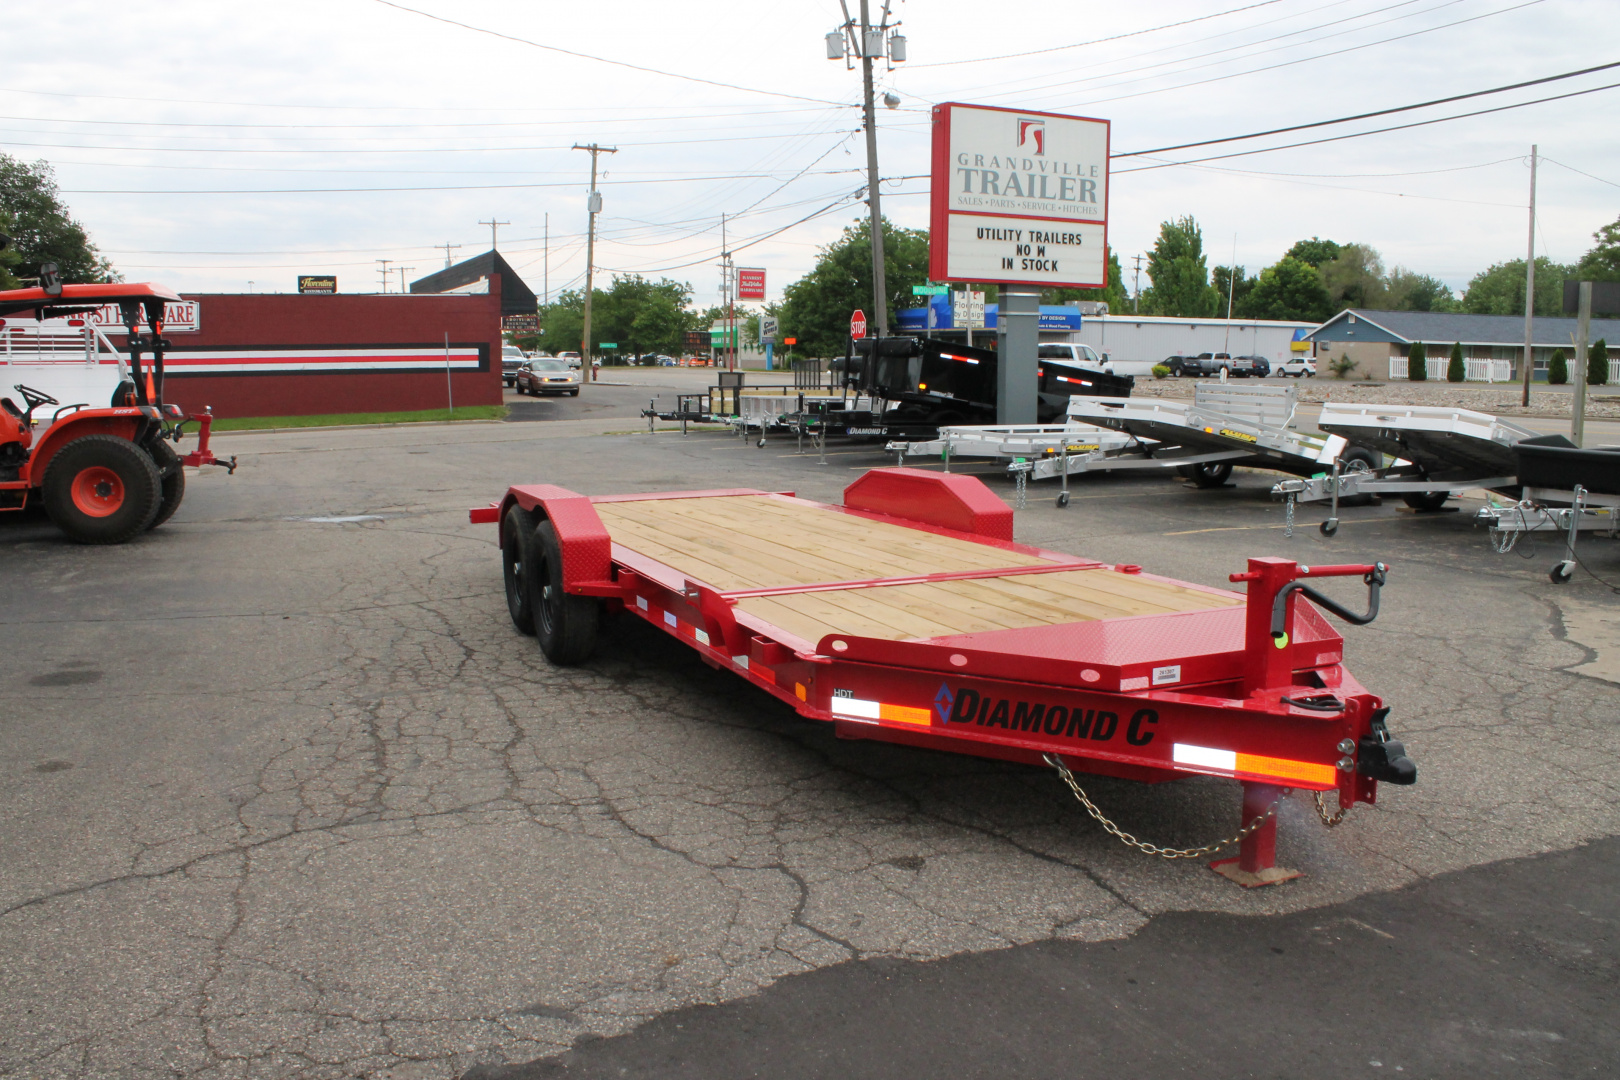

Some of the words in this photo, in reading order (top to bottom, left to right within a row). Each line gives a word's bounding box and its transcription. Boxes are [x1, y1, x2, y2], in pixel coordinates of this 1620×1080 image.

[957, 152, 1099, 178] GRANDVILLE
[957, 167, 1097, 204] TRAILER
[957, 196, 983, 206] SALES
[990, 199, 1015, 208] PARTS
[1022, 201, 1056, 212] SERVICE
[1063, 204, 1098, 215] HITCHES
[977, 227, 1022, 242] UTILITY
[1028, 230, 1082, 246] TRAILERS
[1002, 257, 1014, 270] IN
[1022, 258, 1058, 272] STOCK
[914, 286, 948, 294] WOODBINE
[962, 310, 984, 319] Dsign
[852, 321, 866, 334] STOP
[834, 688, 854, 698] HDT
[950, 688, 1119, 742] DIAMOND
[1126, 708, 1159, 746] C
